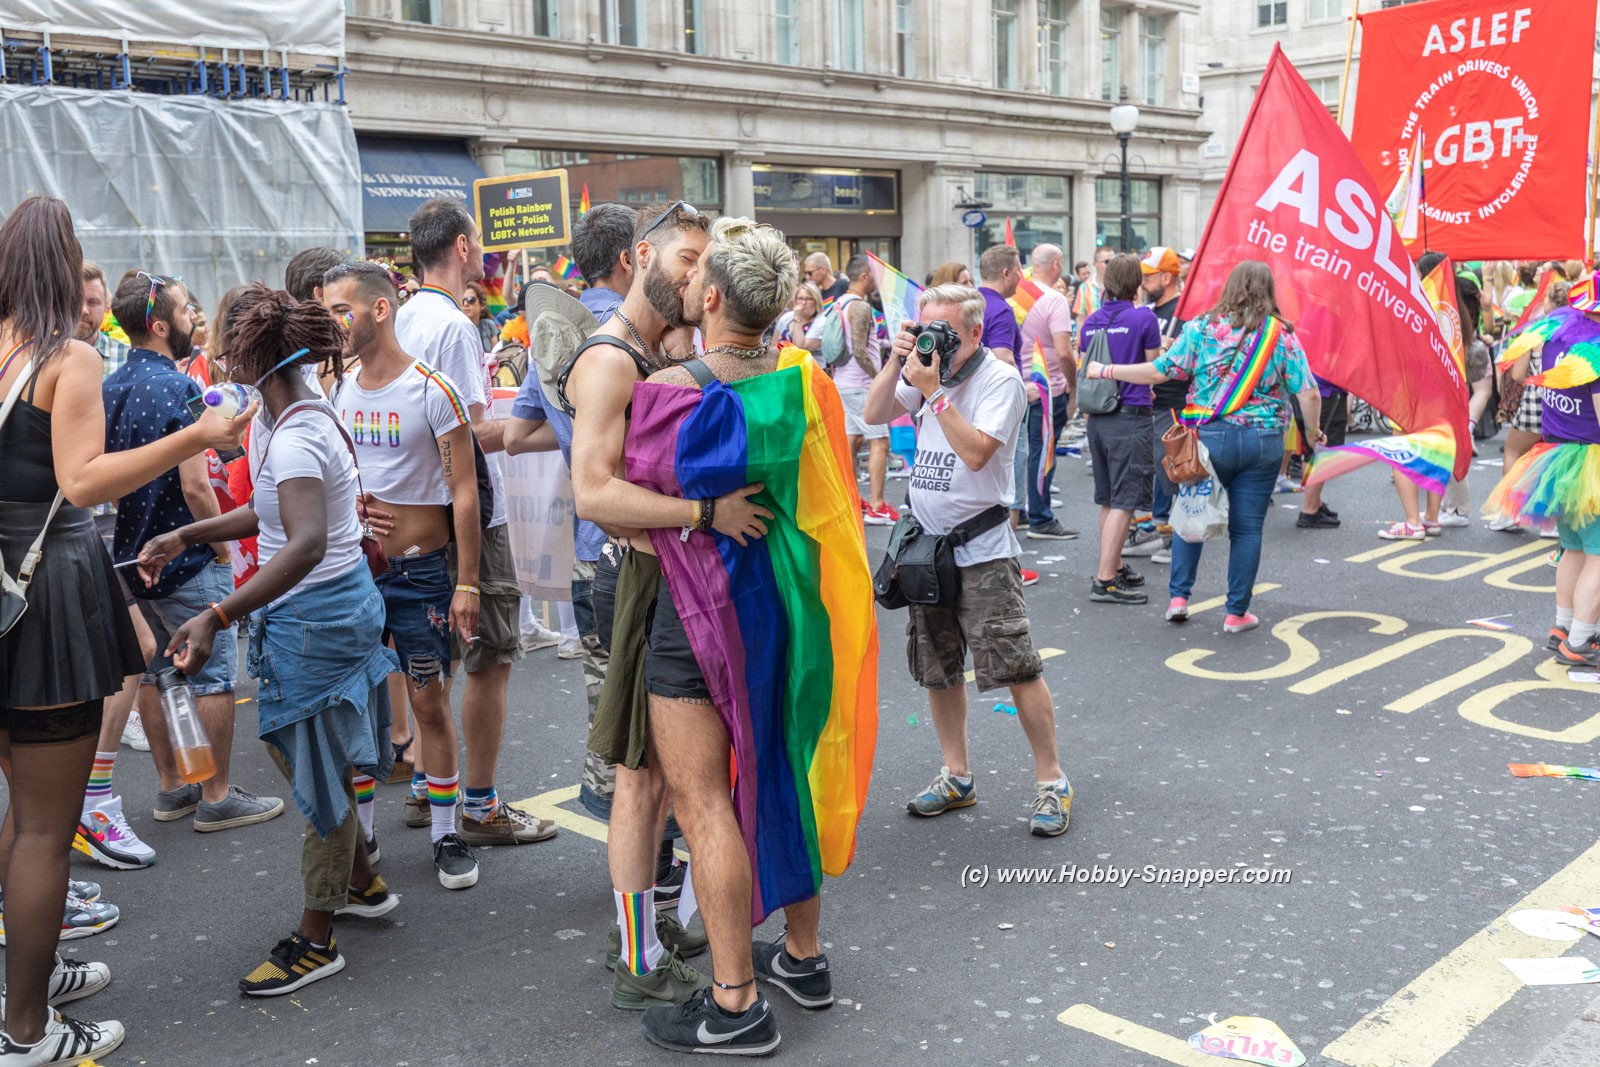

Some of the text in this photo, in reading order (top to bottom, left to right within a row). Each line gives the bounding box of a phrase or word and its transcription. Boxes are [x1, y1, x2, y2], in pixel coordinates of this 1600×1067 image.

[1422, 8, 1532, 57] ASLEF
[1401, 59, 1539, 140] THE TRAIN DRIVERS UNION
[1478, 134, 1538, 219] INTOLERANCE
[366, 187, 467, 200] NEWSAGENTS
[489, 203, 553, 218] Polish Rainbow
[494, 219, 502, 229] in
[503, 217, 516, 227] UK
[522, 213, 550, 225] Polish
[490, 224, 555, 241] LGBT+ Network
[1246, 218, 1288, 254] the
[1294, 235, 1352, 281] train
[1430, 331, 1460, 389] union
[341, 408, 401, 448] OUD
[911, 478, 951, 492] MAGES
